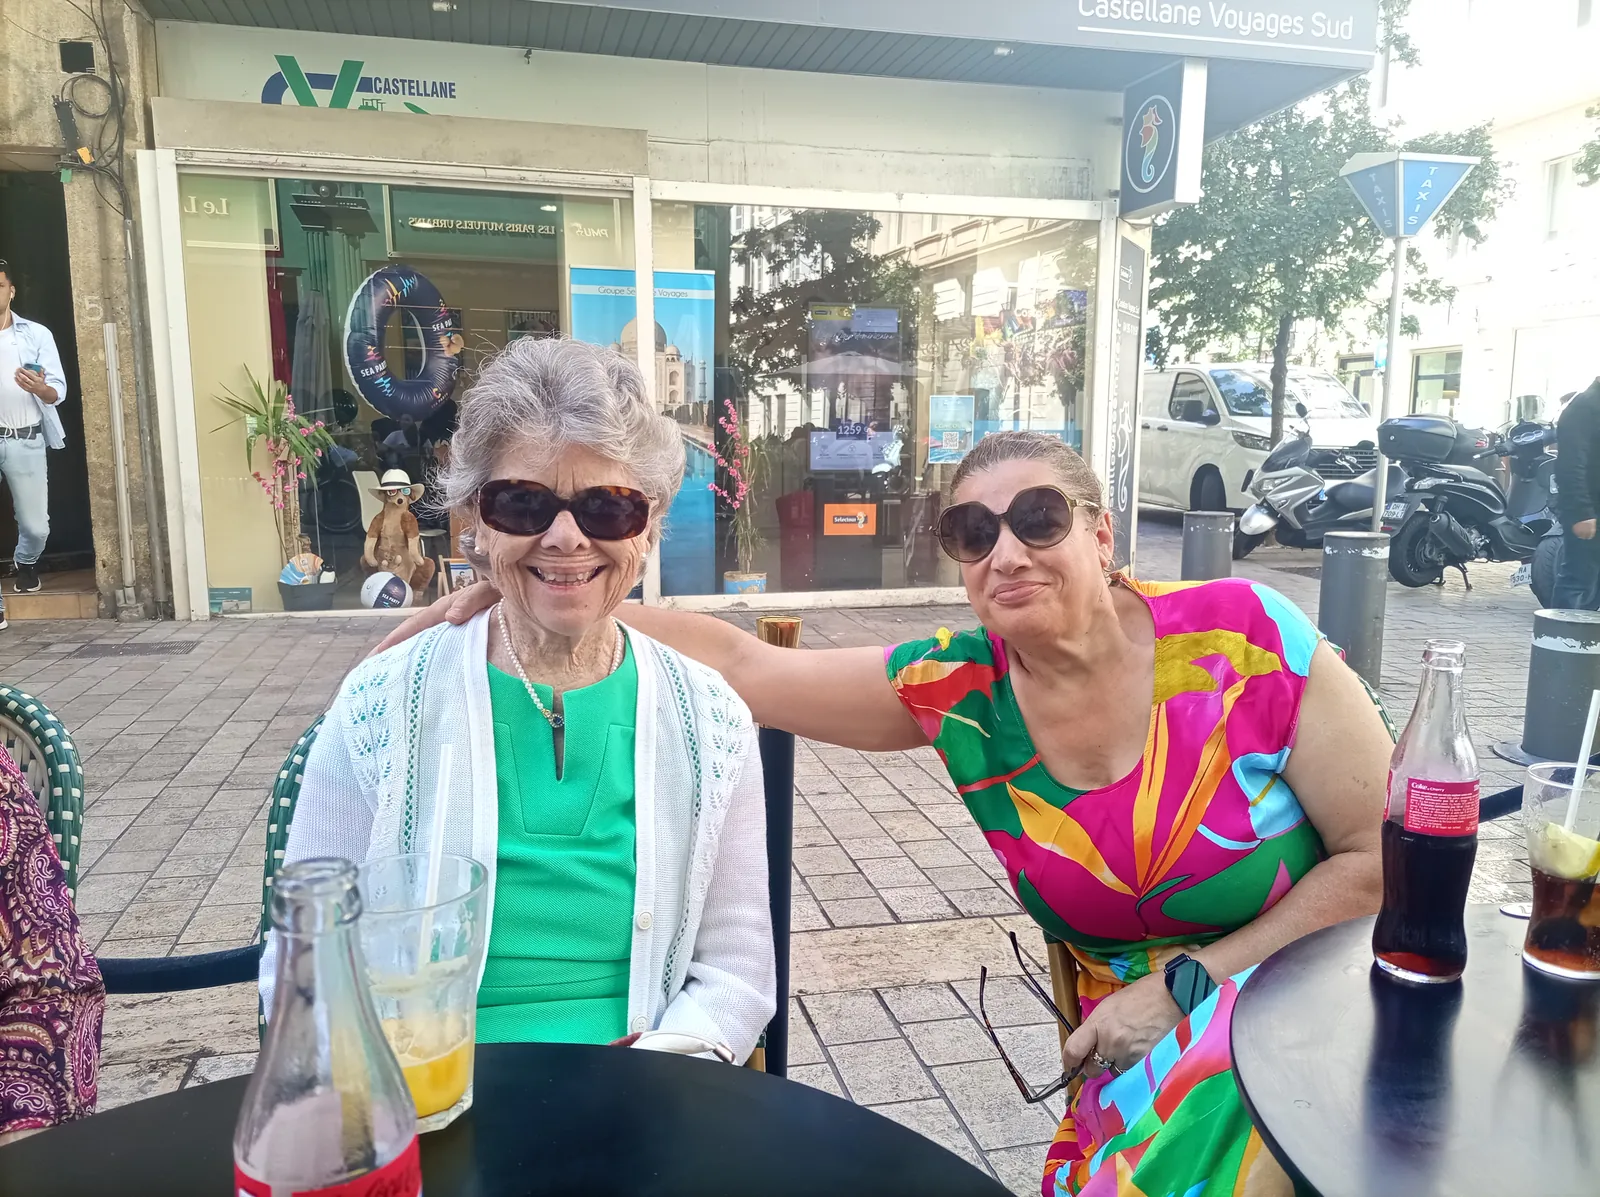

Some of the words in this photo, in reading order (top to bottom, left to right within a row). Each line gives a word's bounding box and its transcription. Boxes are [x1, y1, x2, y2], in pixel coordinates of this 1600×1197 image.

[1078, 0, 1201, 26] Castellane
[1208, 1, 1303, 38] Voyages
[1310, 11, 1353, 40] Sud
[373, 76, 456, 99] CASTELLANE
[1369, 173, 1392, 228] TAXIS
[1407, 166, 1438, 226] TAXIS
[598, 286, 624, 297] Groupe
[658, 288, 688, 299] Voyages
[85, 295, 103, 321] 5
[360, 367, 375, 378] SEA
[838, 425, 861, 435] 1259
[1411, 781, 1428, 791] Coke
